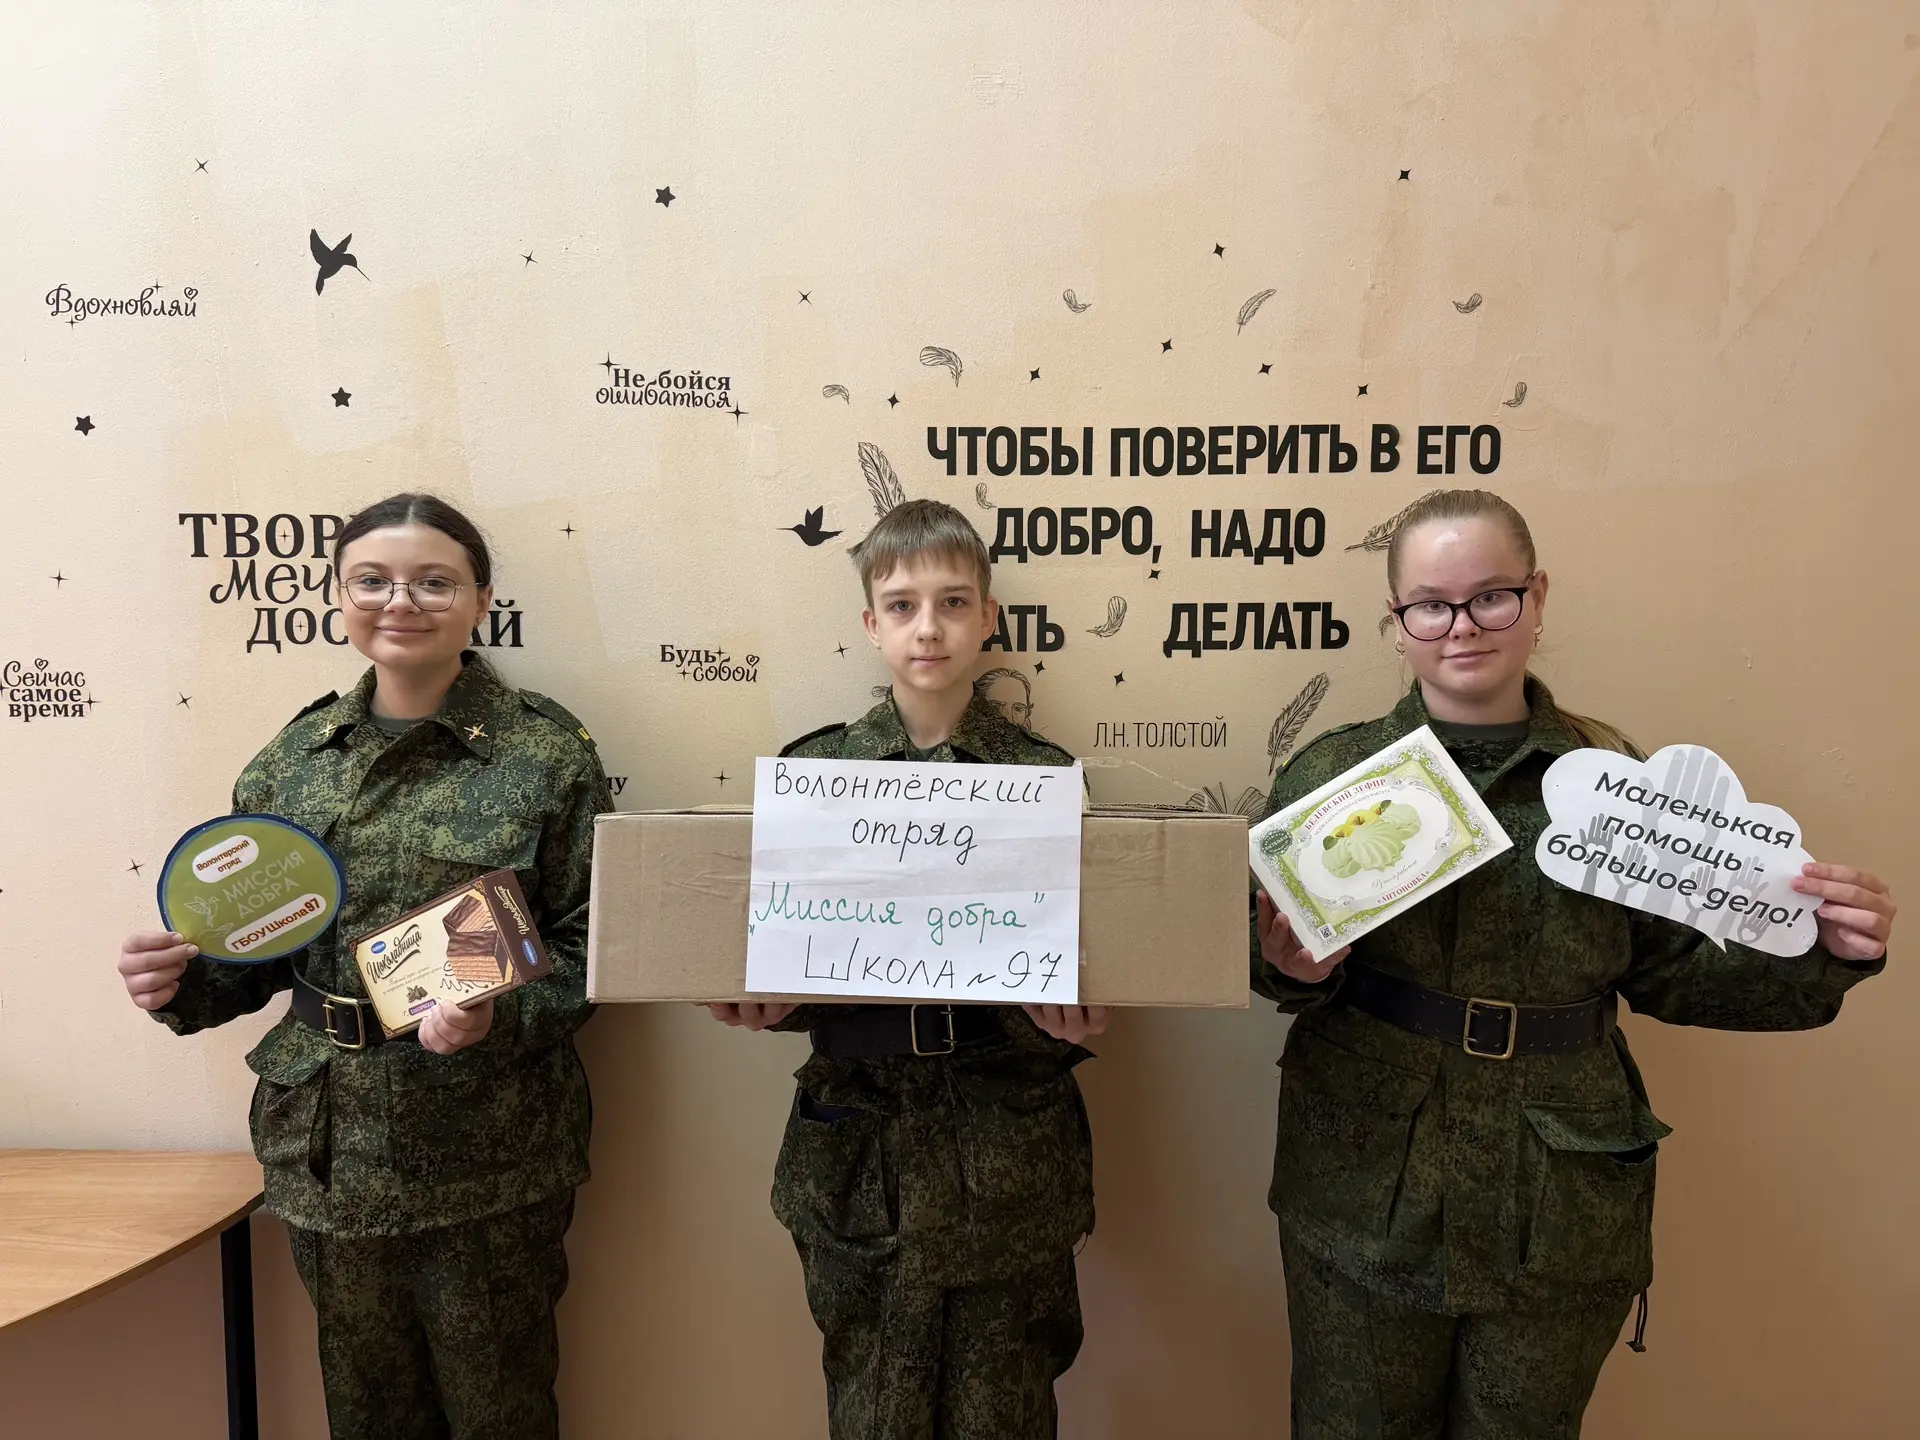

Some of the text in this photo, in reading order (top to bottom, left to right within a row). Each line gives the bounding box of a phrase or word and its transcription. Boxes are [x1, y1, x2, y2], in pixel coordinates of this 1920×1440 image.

[46, 283, 199, 321] Вдохновляй
[596, 379, 732, 408] ошибаться
[613, 368, 731, 391] Не бойся
[927, 423, 1502, 478] ЧТОБЫ ПОВЕРИТЬ В ЕГО
[178, 513, 354, 559] ТВОР
[989, 506, 1326, 566] ДОБРО, НАДО
[979, 601, 1350, 659] АТЬ ДЕЛАТЬ
[3, 657, 86, 688] Сейчас
[659, 644, 717, 667] Будь
[692, 654, 759, 682] собой
[8, 703, 85, 723] время
[9, 688, 82, 702] самое
[774, 762, 1055, 803] Волонтёрский
[1353, 778, 1386, 795] ЗЕФИР
[1594, 772, 1795, 849] Маленькая
[196, 839, 250, 872] Волонтерский
[851, 818, 978, 866] отряд
[1601, 815, 1742, 872] помощь
[217, 857, 242, 873] отряд
[222, 850, 306, 902] МИССИЯ
[1547, 833, 1804, 928] большое дело!
[235, 877, 300, 919] ДОБРА
